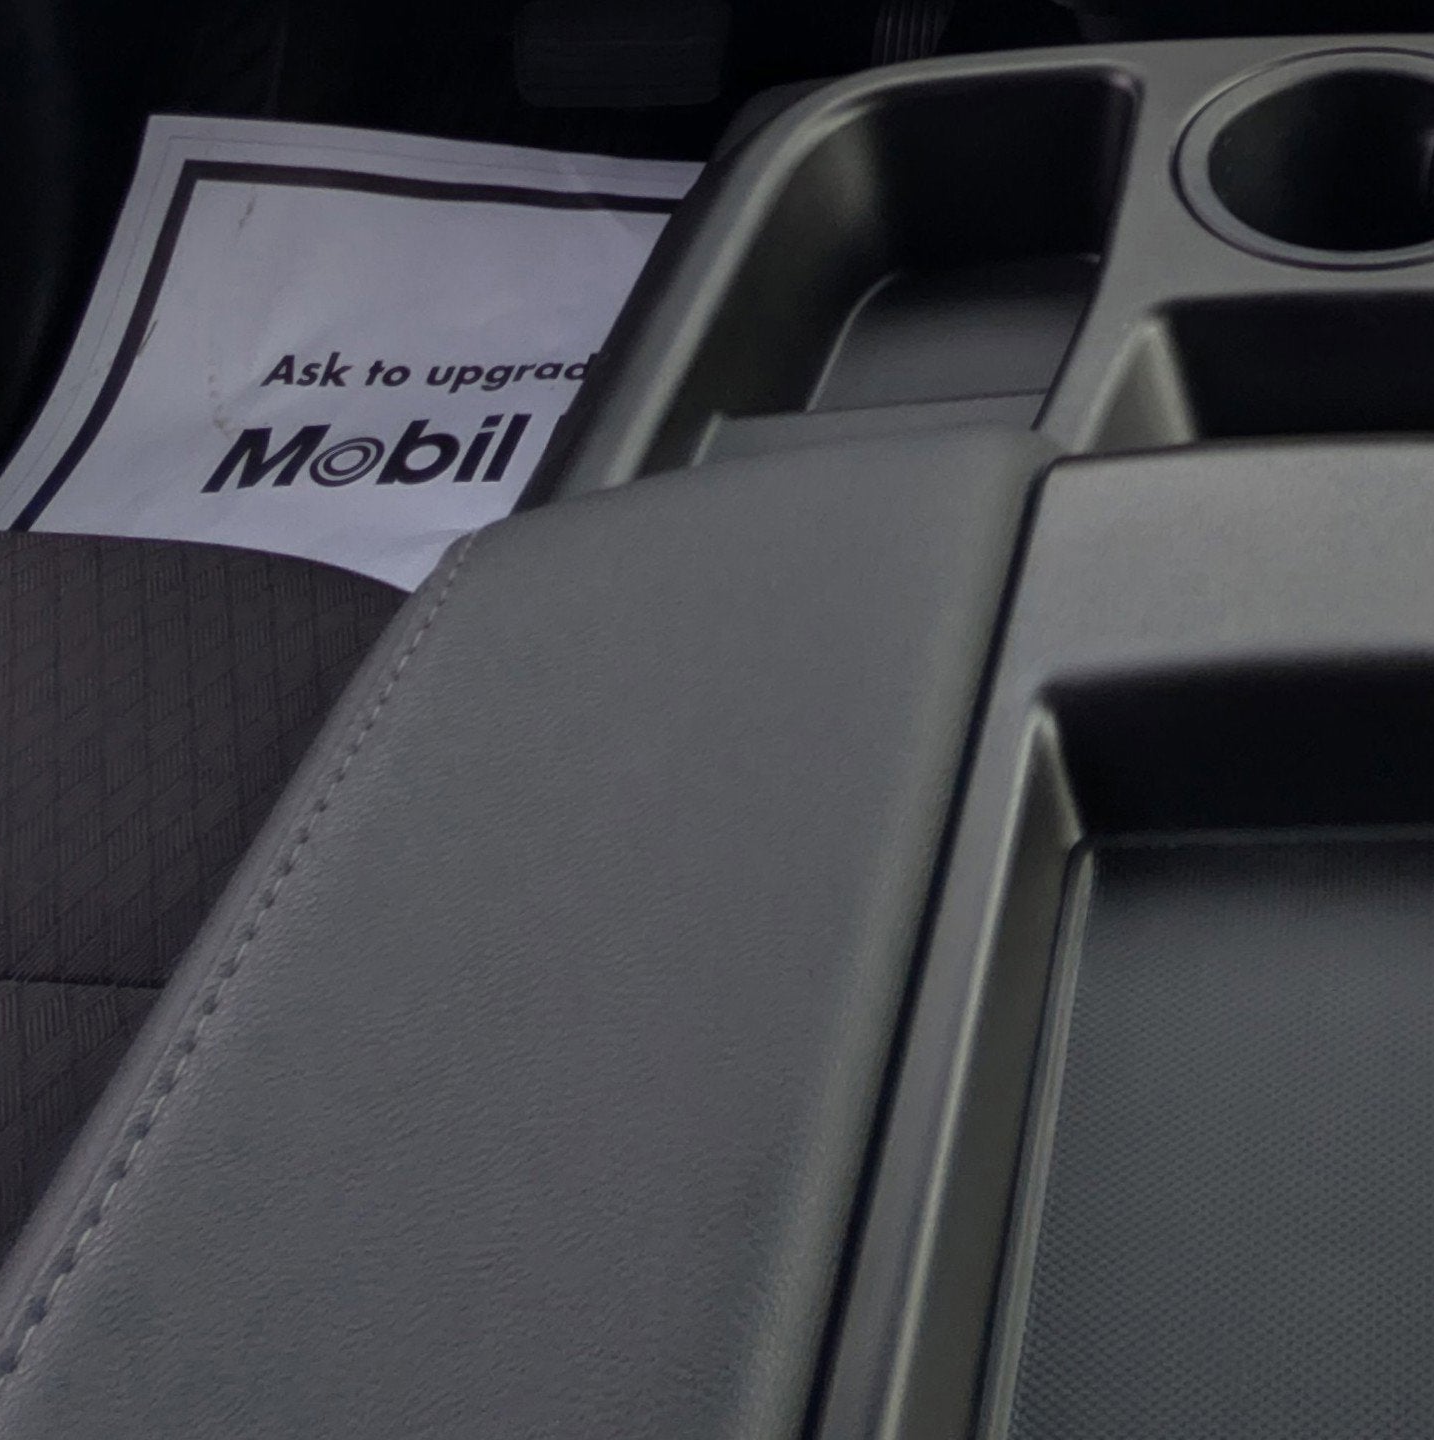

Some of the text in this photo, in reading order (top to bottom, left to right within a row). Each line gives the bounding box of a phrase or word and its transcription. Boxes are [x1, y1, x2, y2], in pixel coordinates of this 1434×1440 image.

[260, 351, 596, 394] Ask to upgrad
[200, 413, 532, 494] Mobil
